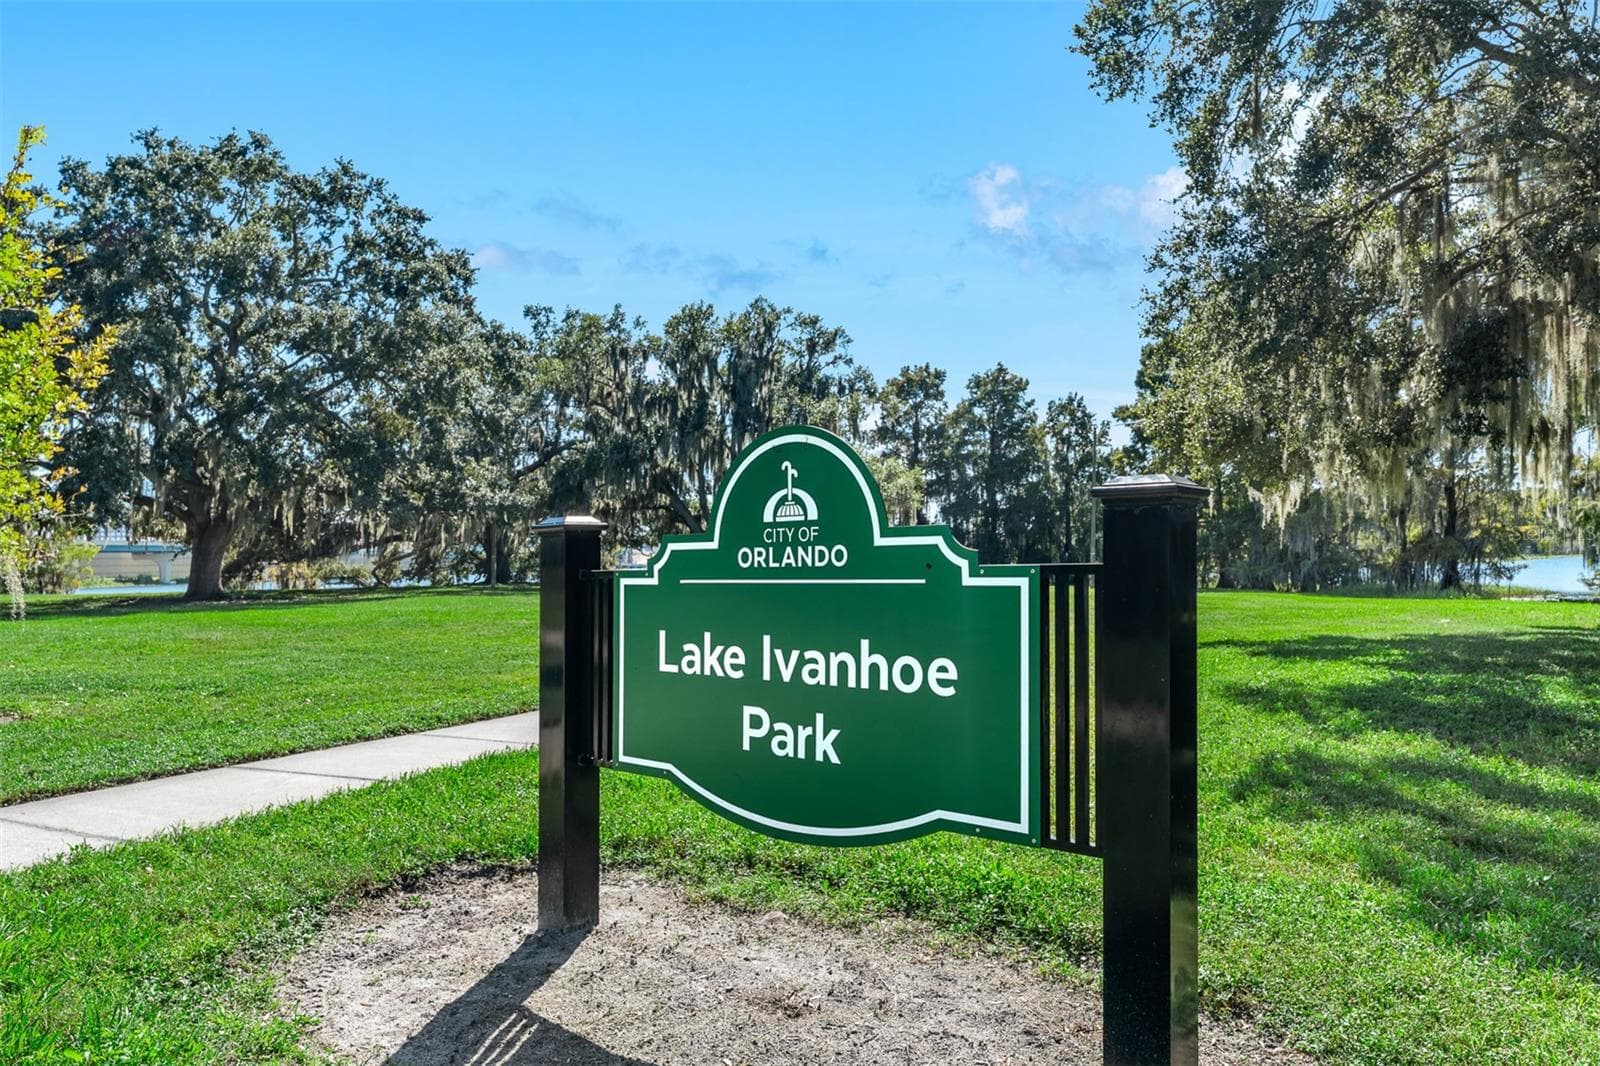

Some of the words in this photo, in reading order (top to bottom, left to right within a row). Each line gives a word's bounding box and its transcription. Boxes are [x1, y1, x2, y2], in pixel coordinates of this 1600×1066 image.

[763, 527, 793, 543] CITY
[798, 526, 819, 542] OF
[737, 545, 848, 568] ORLANDO
[658, 629, 746, 679] Lake
[762, 634, 959, 697] Ivanhoe
[742, 705, 841, 765] Park
